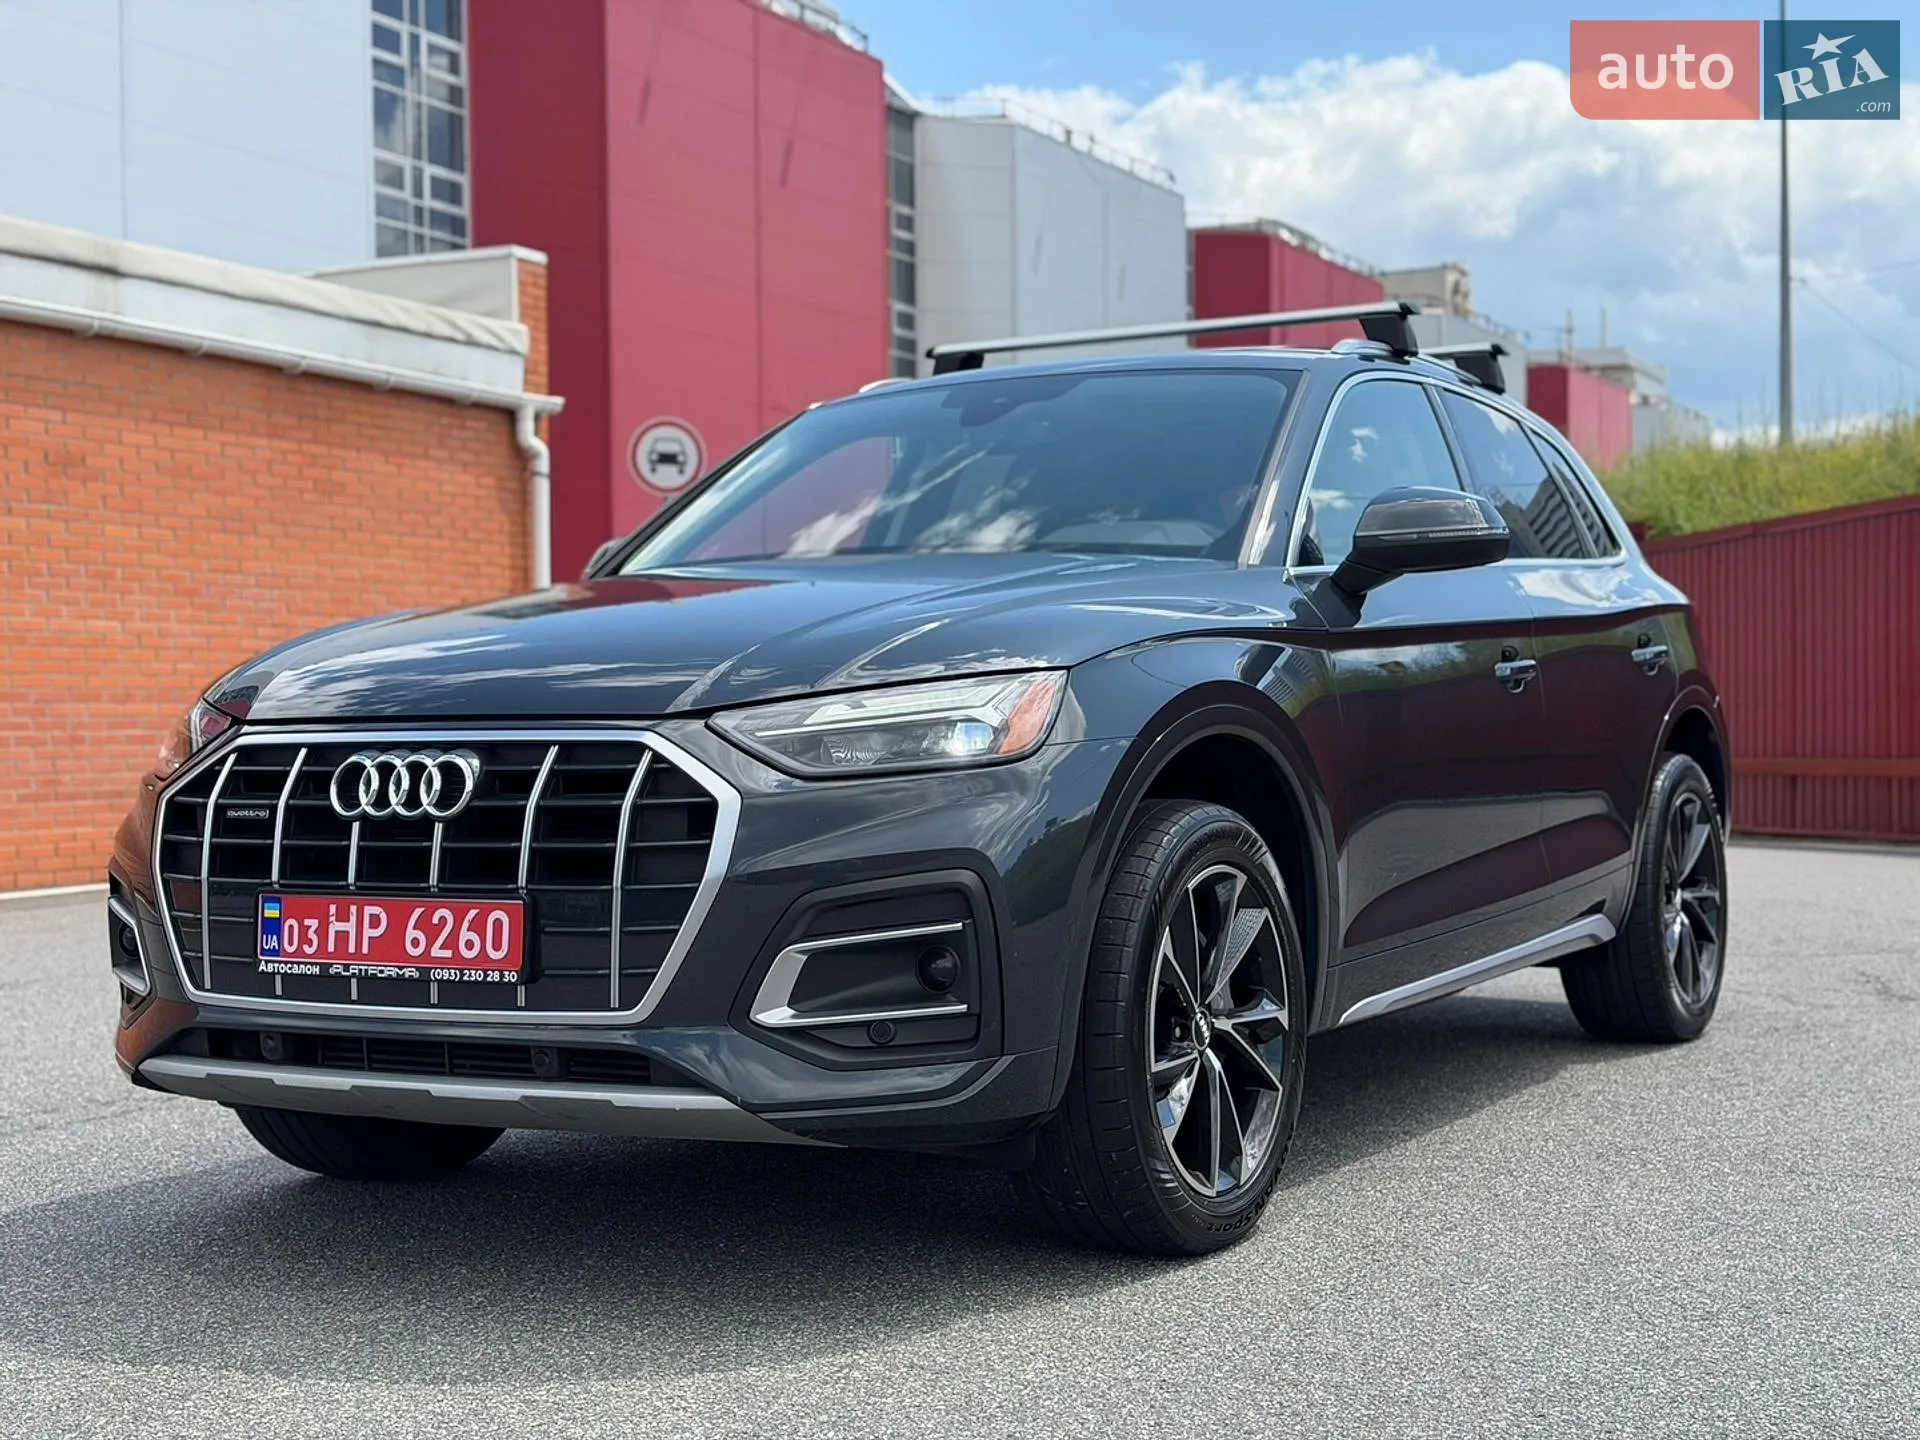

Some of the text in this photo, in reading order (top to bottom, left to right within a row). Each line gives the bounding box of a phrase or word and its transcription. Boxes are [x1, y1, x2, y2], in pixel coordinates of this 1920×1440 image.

[283, 903, 509, 960] 03 HP 6260
[262, 934, 279, 950] UA
[258, 960, 320, 975] Автосалон
[430, 968, 518, 983] (093) 230 28 30
